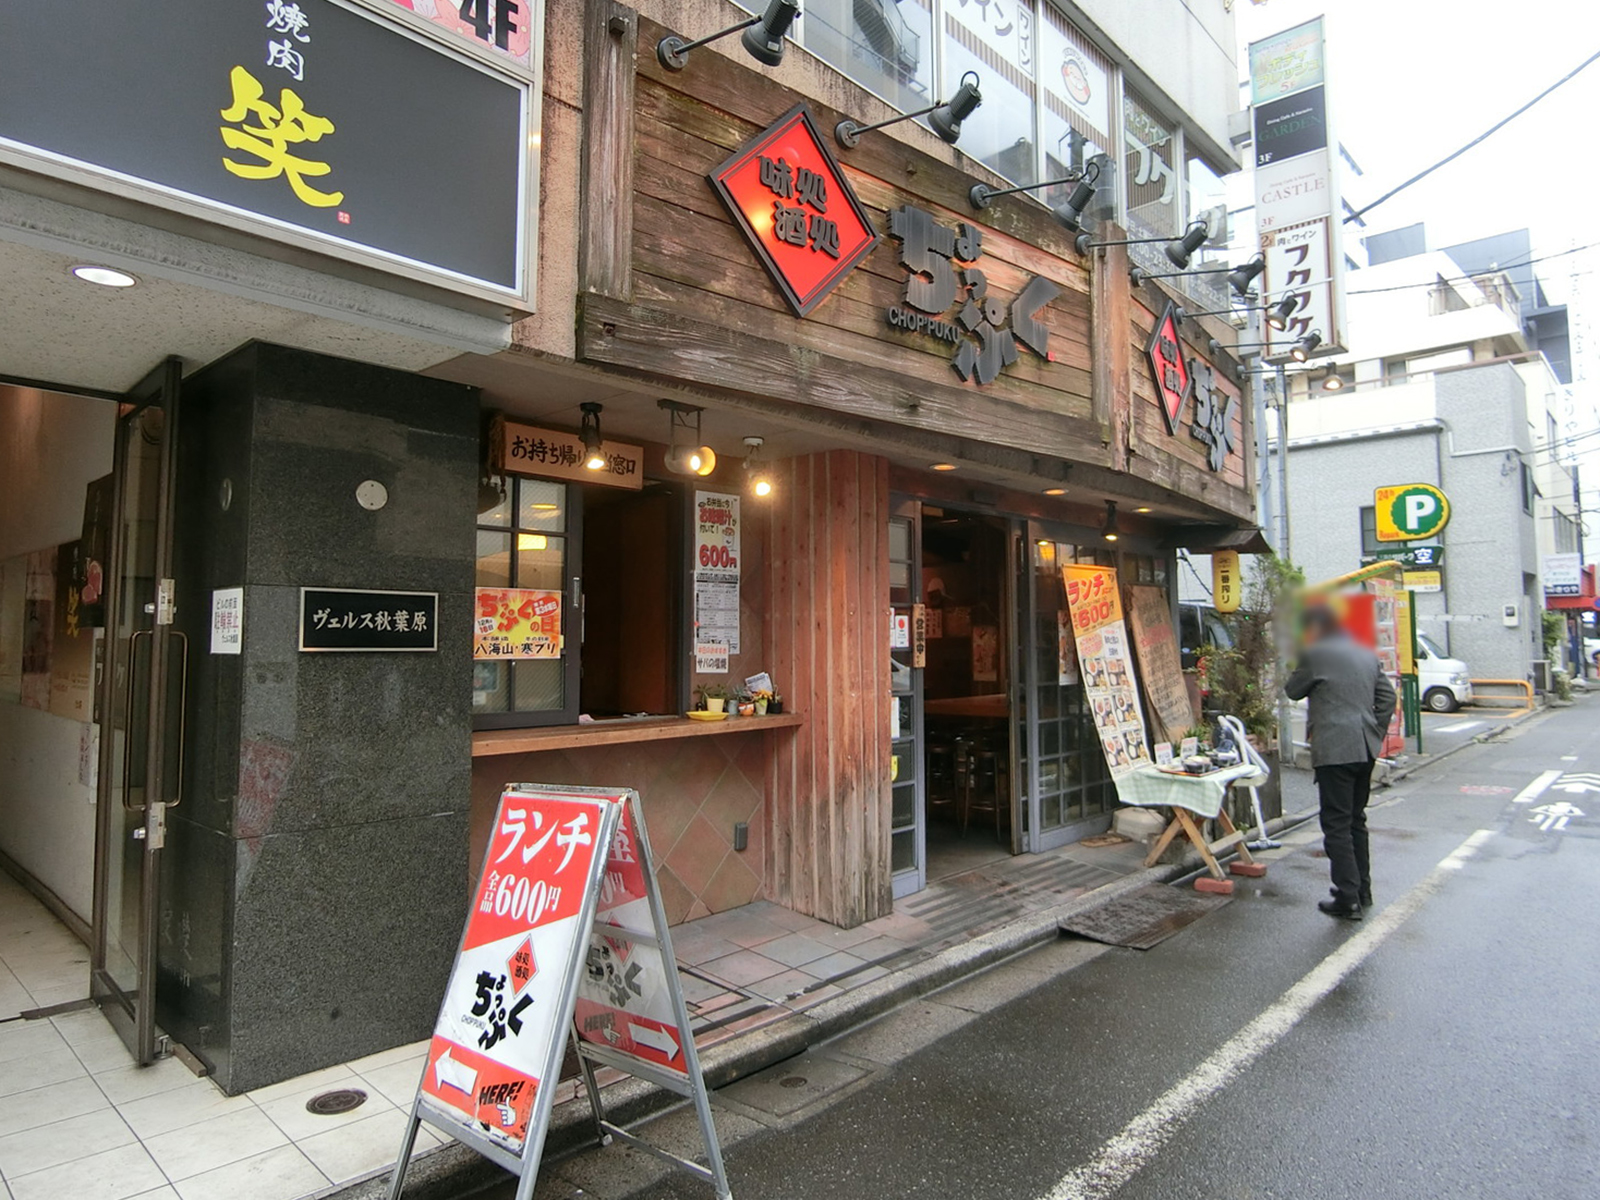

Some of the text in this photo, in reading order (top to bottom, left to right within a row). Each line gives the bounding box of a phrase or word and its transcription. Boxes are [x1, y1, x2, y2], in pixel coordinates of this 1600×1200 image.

[459, 0, 519, 51] 4F
[220, 65, 345, 208] 笑
[1258, 115, 1321, 141] GARDEN
[1258, 152, 1273, 165] 3F
[759, 155, 828, 215] 味処
[1261, 177, 1325, 205] CASTLE
[770, 200, 841, 260] 酒処
[1261, 216, 1275, 228] 3F
[1404, 494, 1436, 530] P
[699, 544, 737, 569] 600円
[1414, 548, 1433, 564] 空
[1067, 573, 1105, 606] ランチ
[312, 607, 428, 632] ヴェルス秋葉原
[494, 807, 592, 876] ランチ
[479, 869, 562, 924] 全品 600円
[479, 1080, 526, 1106] HERE!
